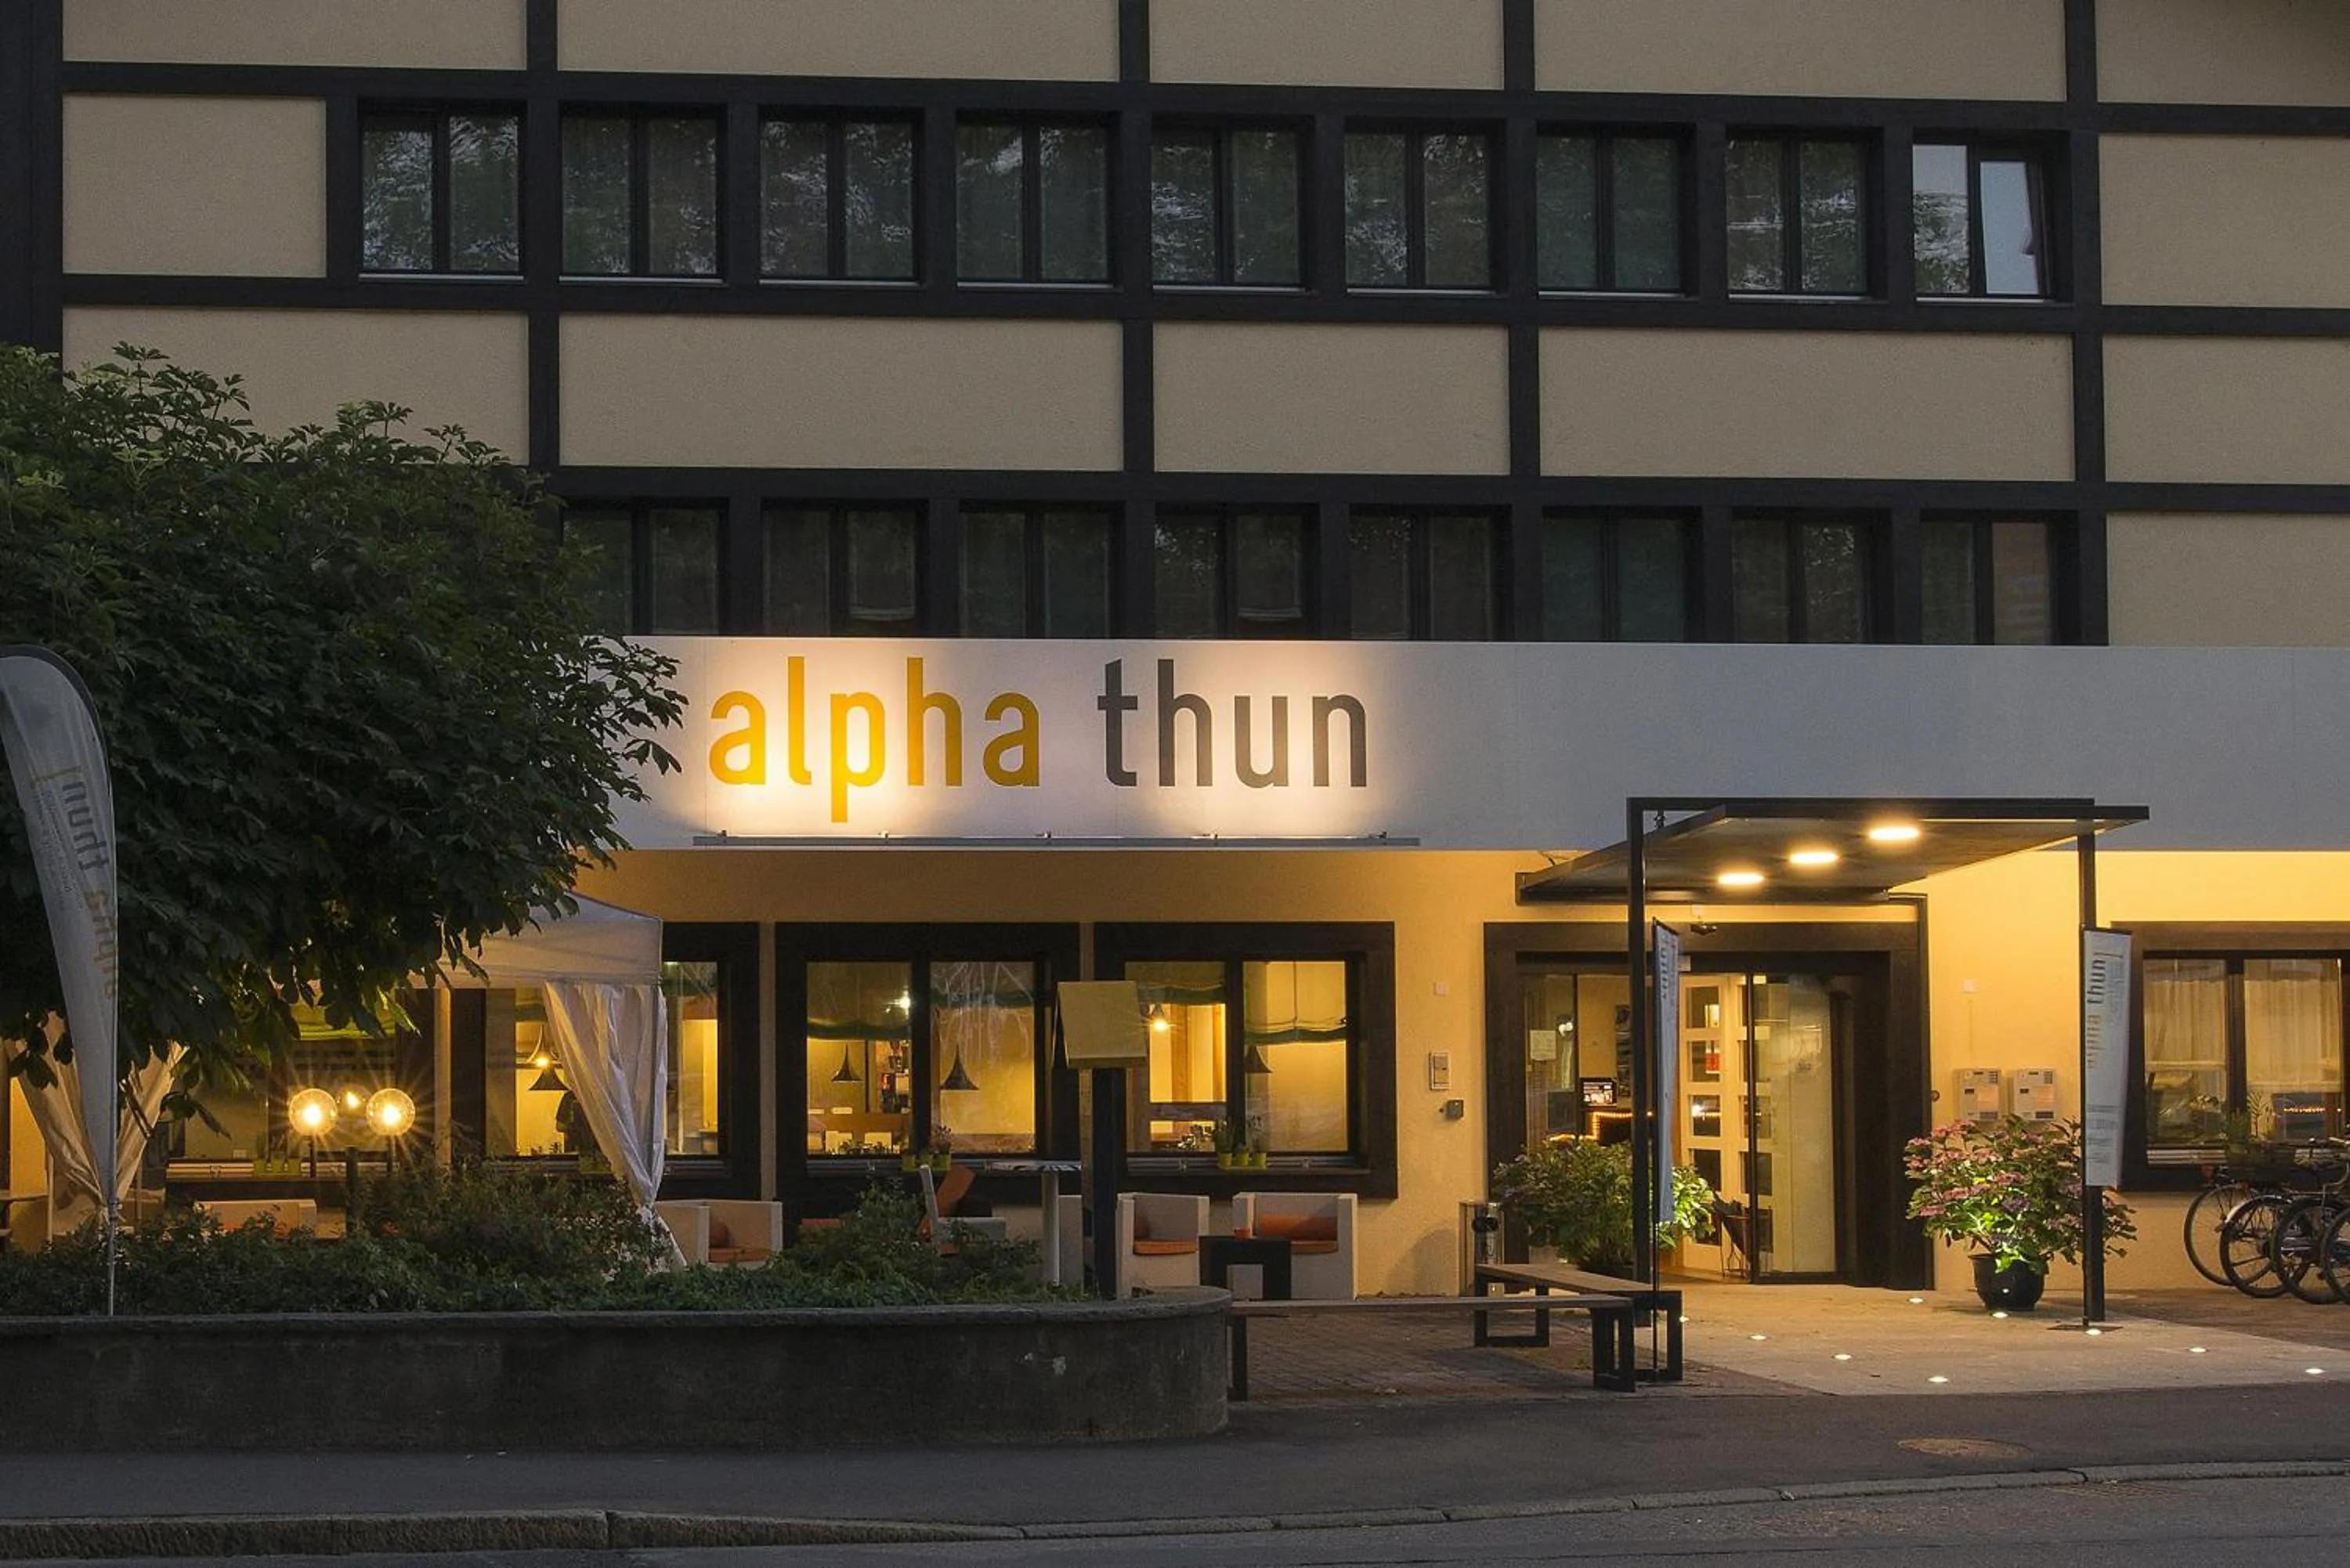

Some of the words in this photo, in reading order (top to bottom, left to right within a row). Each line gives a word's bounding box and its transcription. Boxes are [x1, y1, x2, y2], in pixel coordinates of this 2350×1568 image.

[709, 656, 1039, 822] alpha
[1097, 658, 1367, 788] thun
[2086, 959, 2106, 1003] thun
